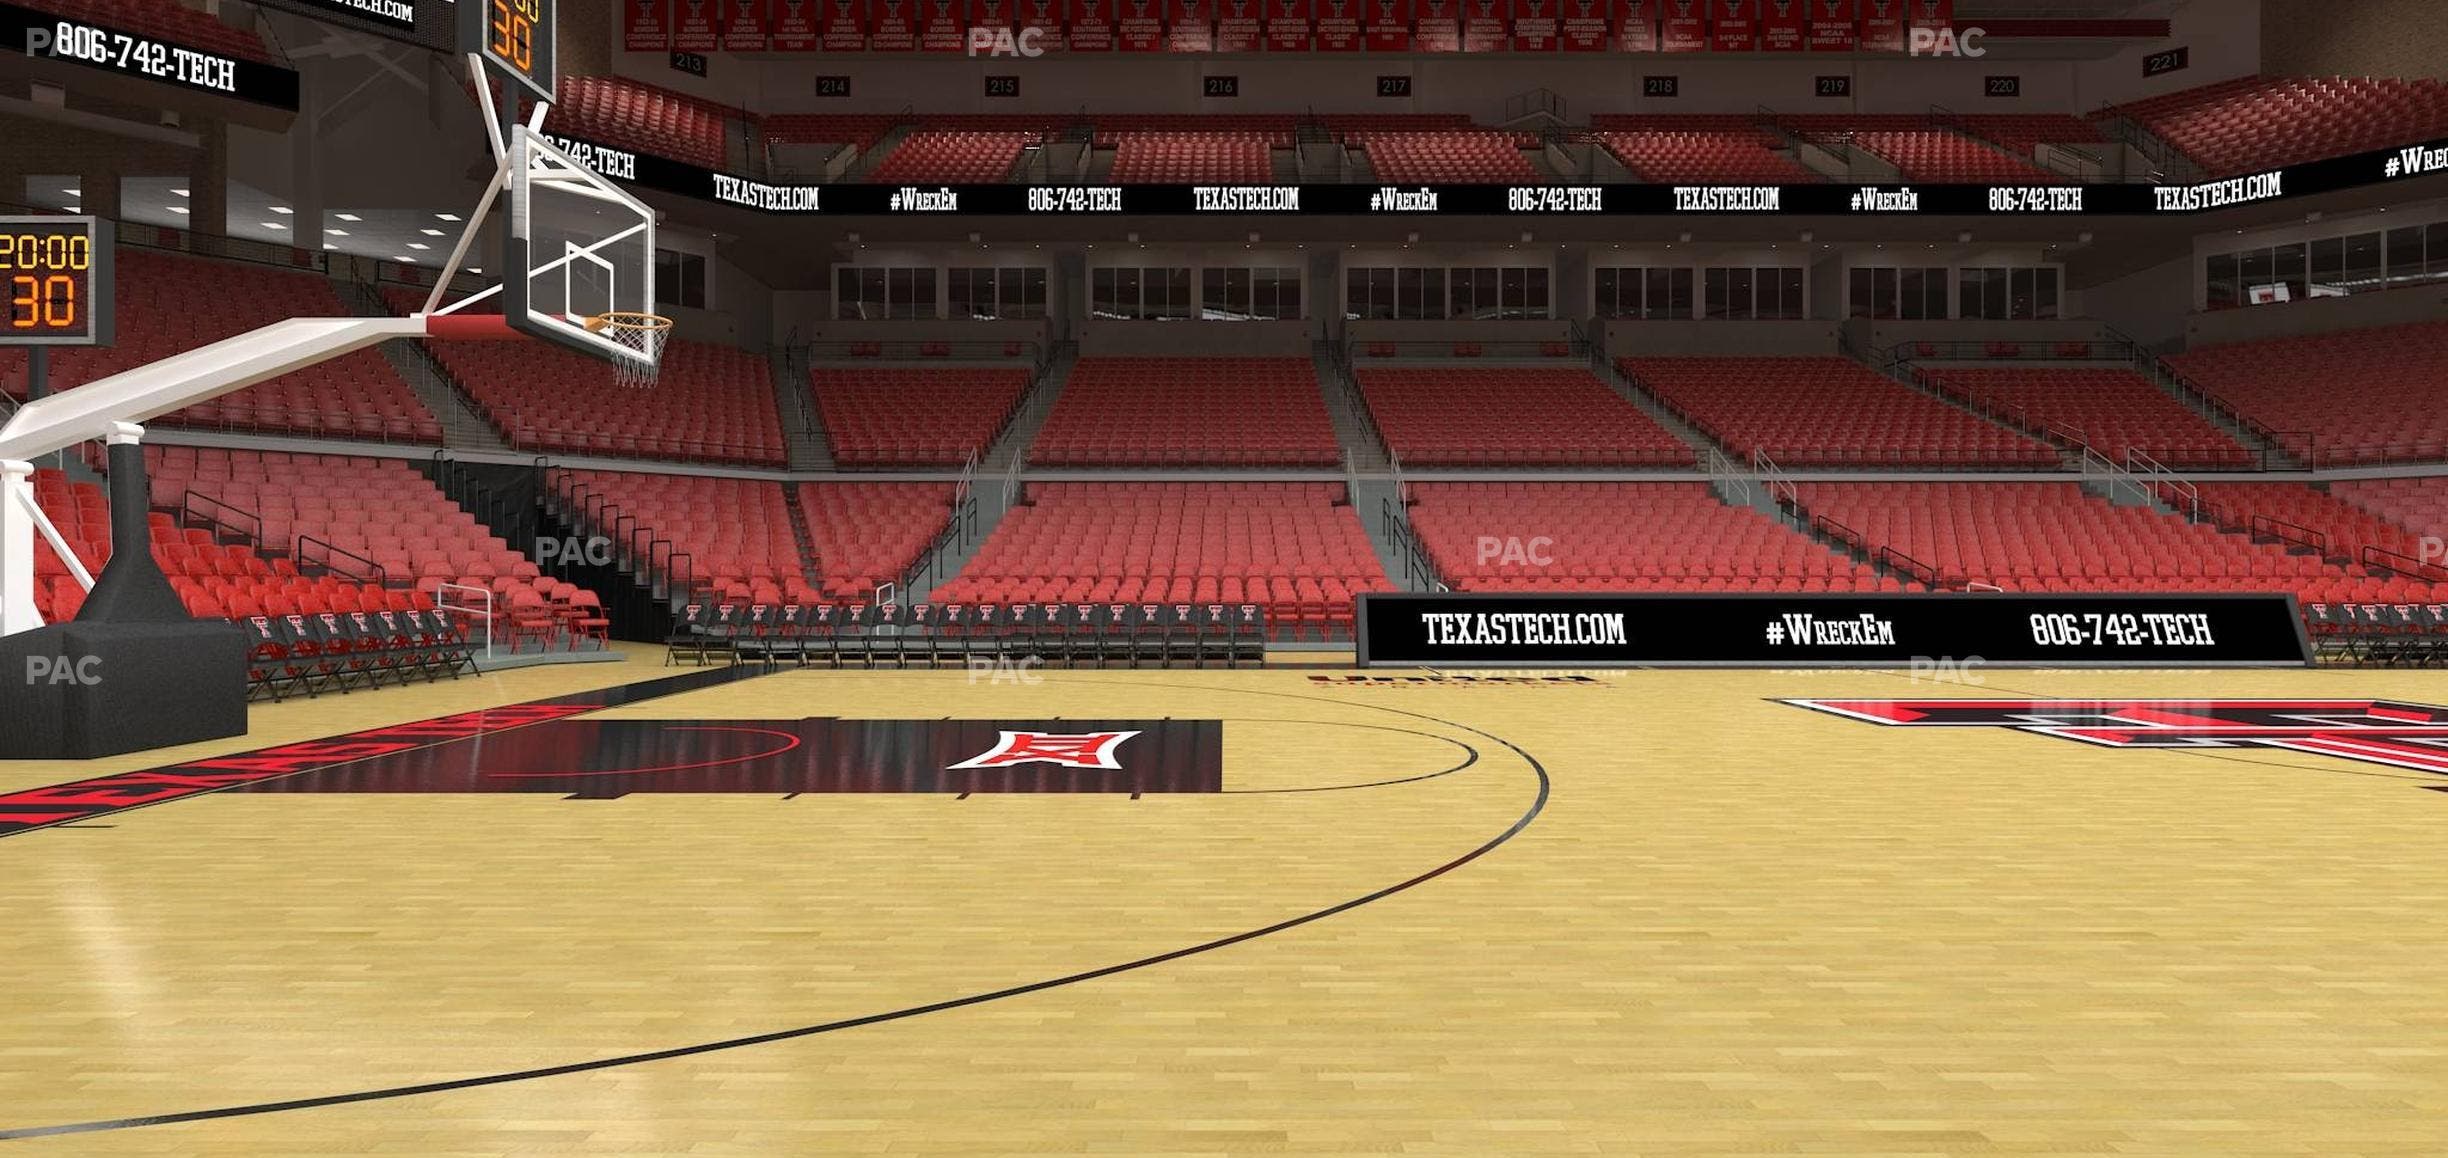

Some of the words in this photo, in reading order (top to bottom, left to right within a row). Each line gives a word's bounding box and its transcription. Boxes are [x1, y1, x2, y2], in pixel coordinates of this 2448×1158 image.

[57, 22, 235, 92] 806-742-TECH
[676, 54, 702, 72] 213
[2151, 53, 2178, 71] 221
[821, 80, 845, 93] 214
[991, 80, 1014, 93] 215
[1209, 80, 1233, 93] 216
[1382, 80, 1405, 93] 217
[1649, 80, 1673, 93] 218
[1821, 80, 1845, 93] 219
[1991, 80, 2015, 93] 220
[714, 174, 819, 211] TEXASTECH.COM
[1028, 187, 1122, 211] 806-742-TECH
[1193, 187, 1300, 211] TEXASTECH.COM
[1508, 187, 1602, 211] 806-742-TECH
[1673, 187, 1780, 211] TEXASTECH.COM
[1988, 187, 2083, 211] 806-742-TECH
[2153, 171, 2282, 211] TEXASTECH.COM
[0, 234, 90, 270] 20:00
[13, 275, 74, 327] 30
[1421, 613, 1628, 645] TEXASTECH.COM
[2029, 613, 2216, 646] 806-742-TECH
